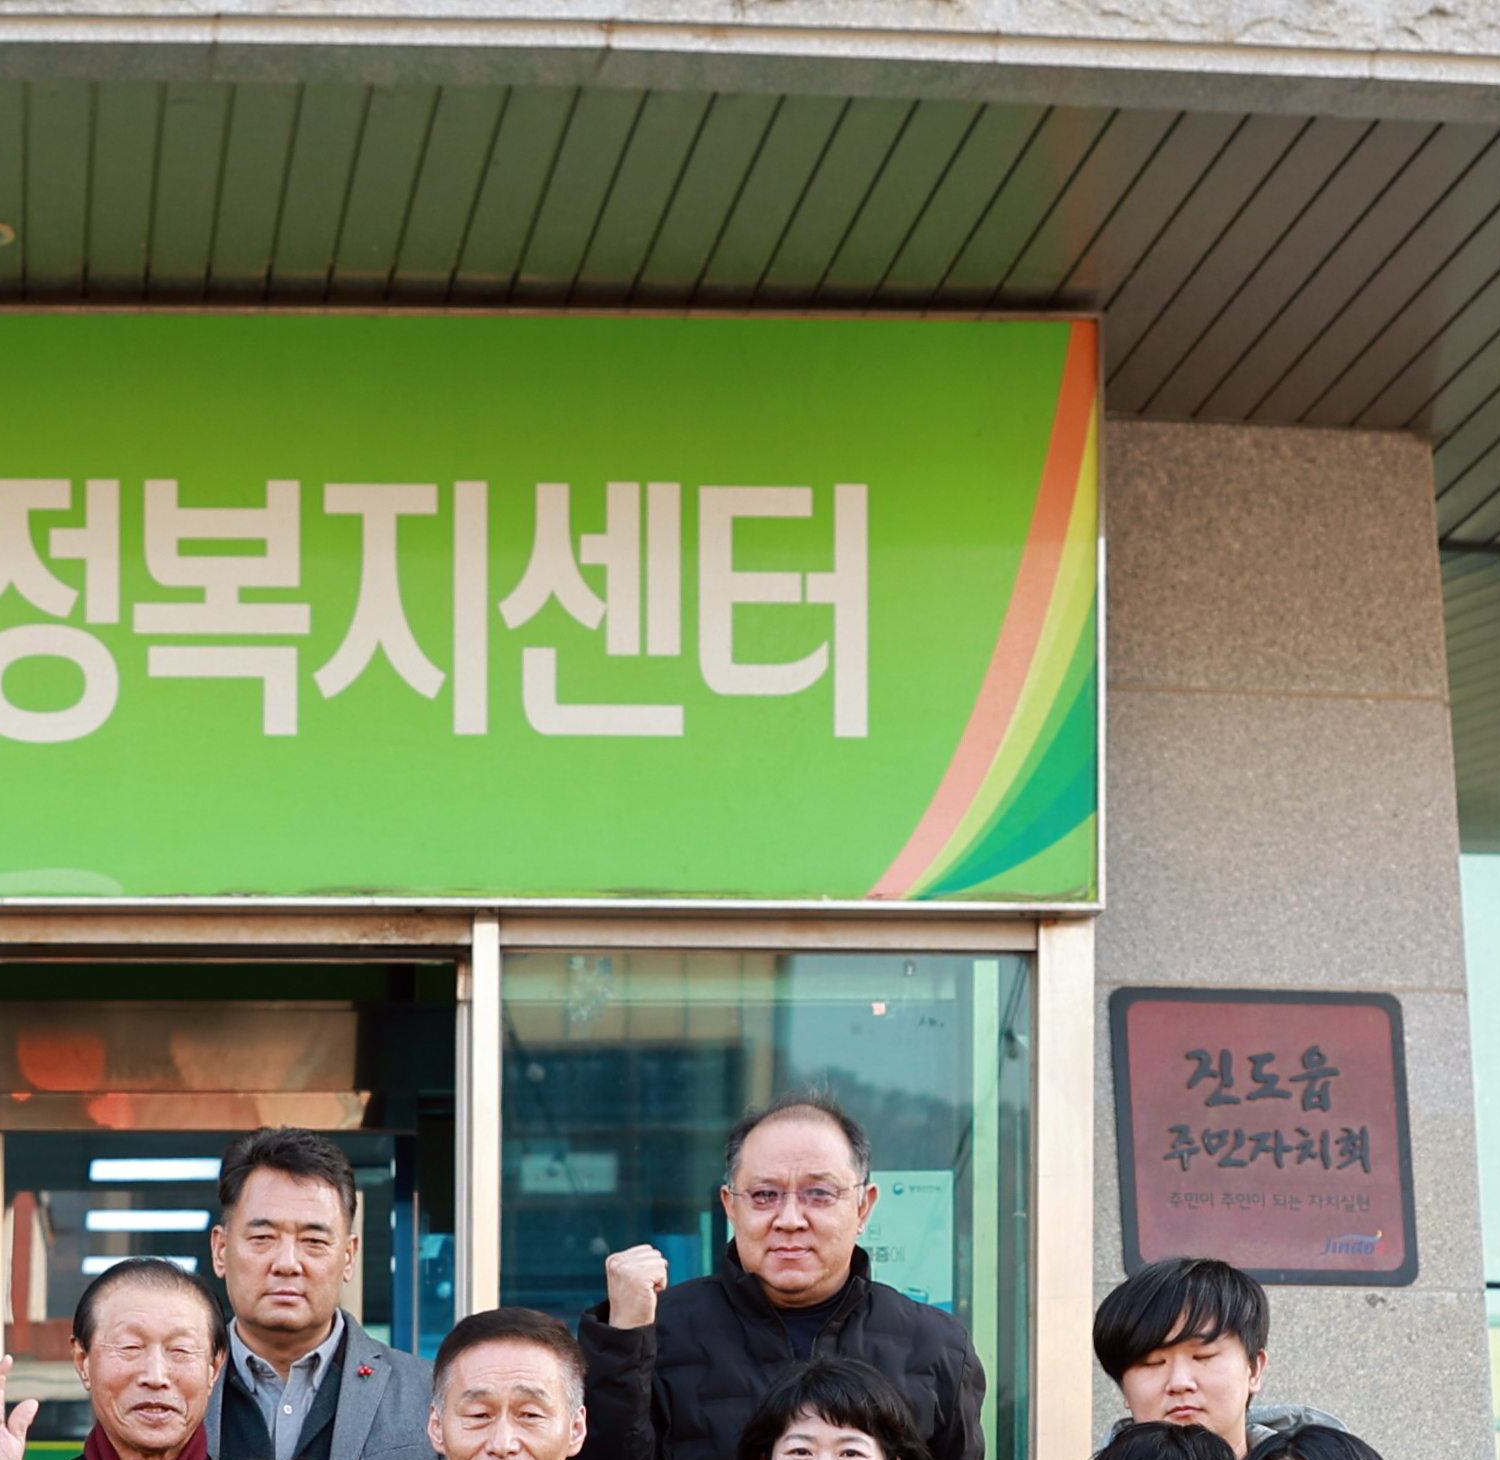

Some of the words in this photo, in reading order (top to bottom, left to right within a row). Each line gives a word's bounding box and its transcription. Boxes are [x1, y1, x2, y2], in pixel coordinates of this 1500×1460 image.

[1185, 1046, 1340, 1112] 진도읍
[1163, 1124, 1371, 1173] 주민자치회
[1169, 1192, 1215, 1209] 주민이
